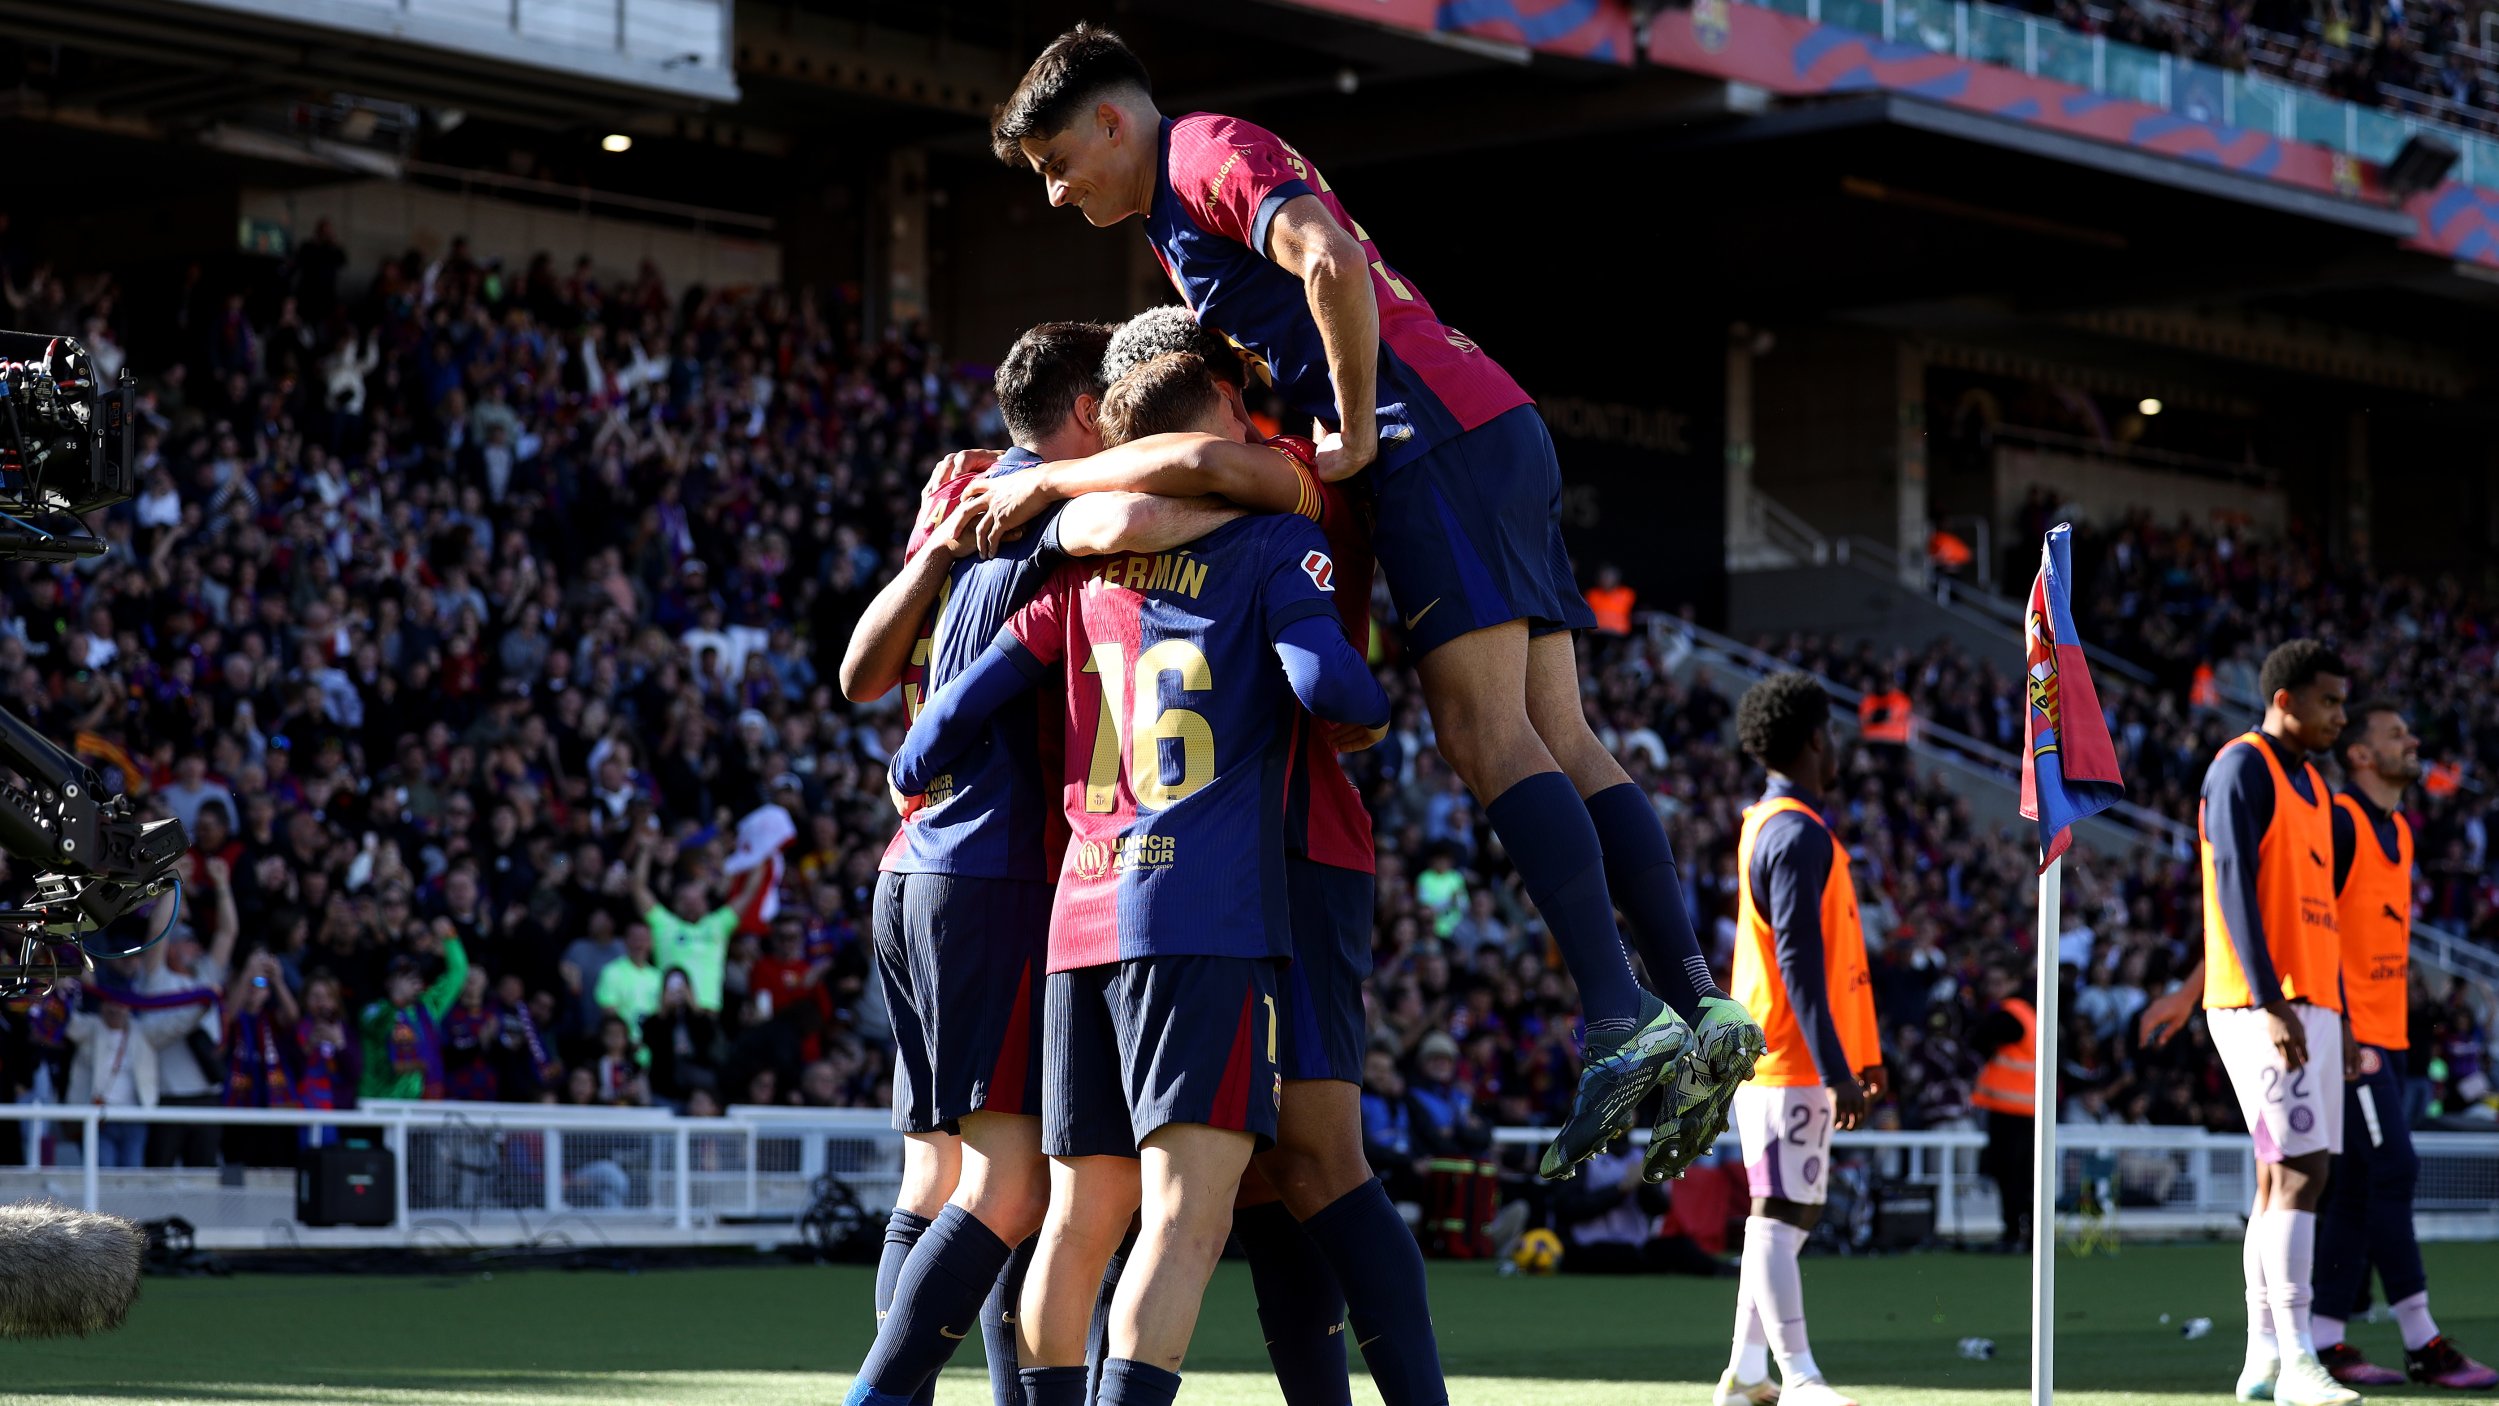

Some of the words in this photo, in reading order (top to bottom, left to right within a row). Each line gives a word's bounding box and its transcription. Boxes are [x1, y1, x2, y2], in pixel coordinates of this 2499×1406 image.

[1206, 152, 1240, 210] AMBILIGHT
[1081, 637, 1216, 814] 16
[1111, 834, 1176, 853] UNHCR
[1112, 849, 1175, 869] ACNUR
[2261, 1064, 2310, 1104] 22
[1789, 1104, 1830, 1149] 27
